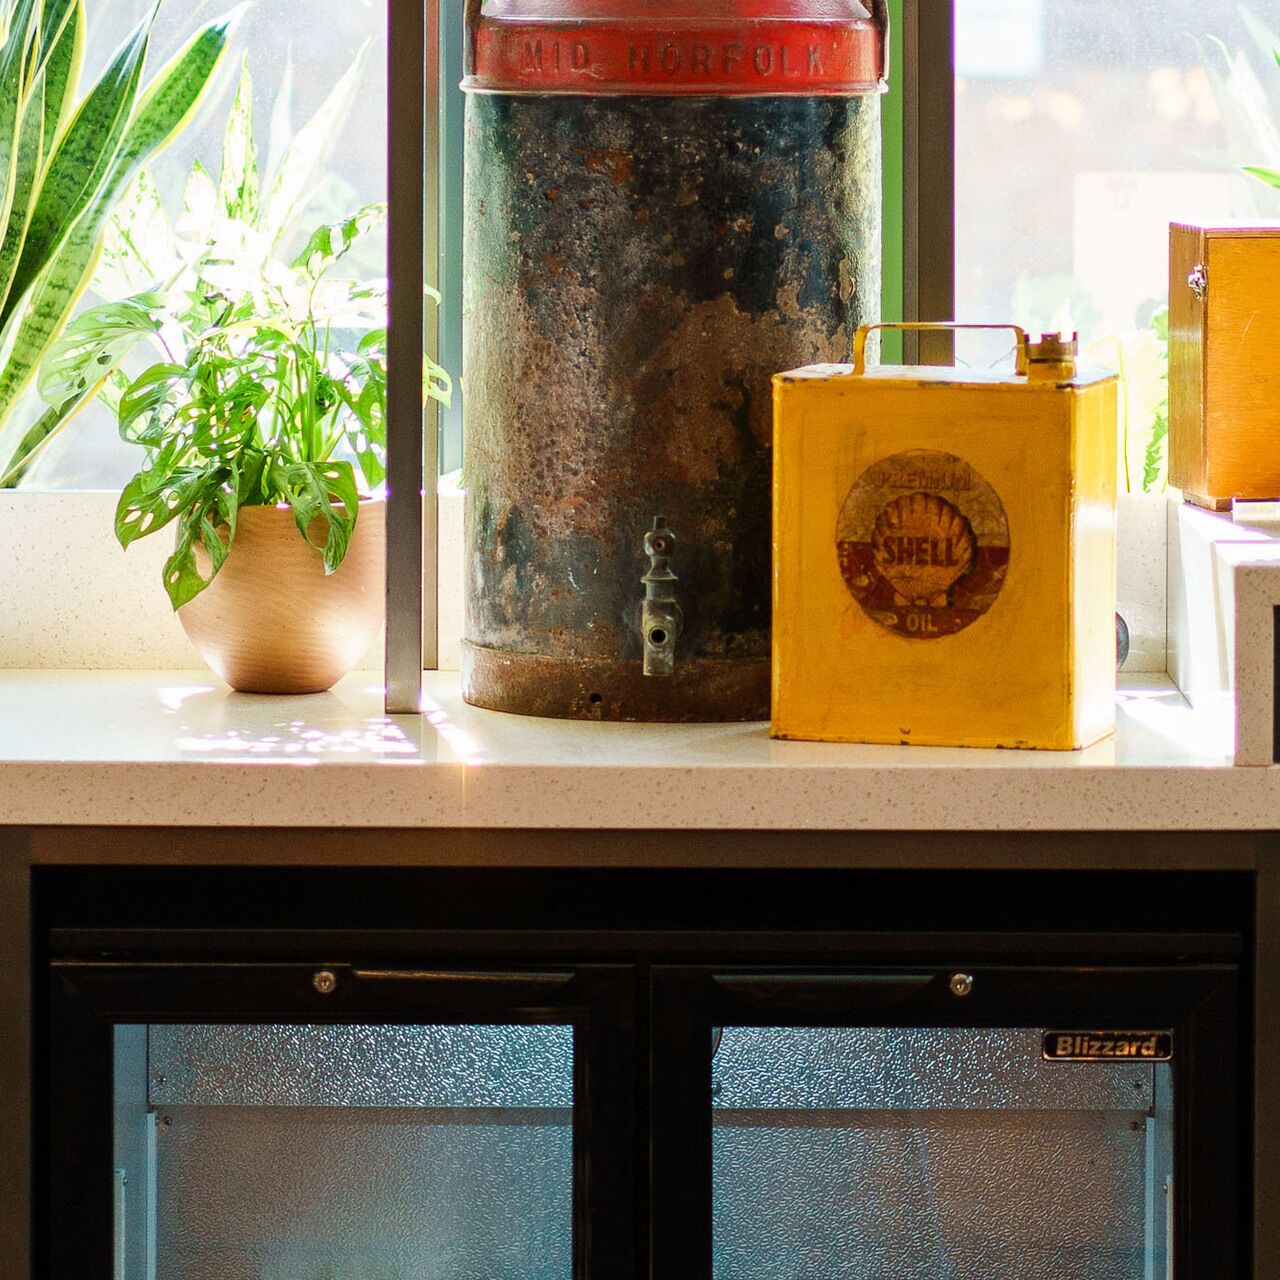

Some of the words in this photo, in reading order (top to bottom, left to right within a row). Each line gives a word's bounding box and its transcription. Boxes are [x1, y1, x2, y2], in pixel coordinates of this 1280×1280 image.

[523, 38, 590, 72] MID
[628, 41, 826, 76] NORFOLK
[879, 471, 971, 490] PREMIUM
[882, 536, 960, 568] SHELL
[906, 614, 938, 632] OIL
[1056, 1036, 1157, 1056] Blizzard
